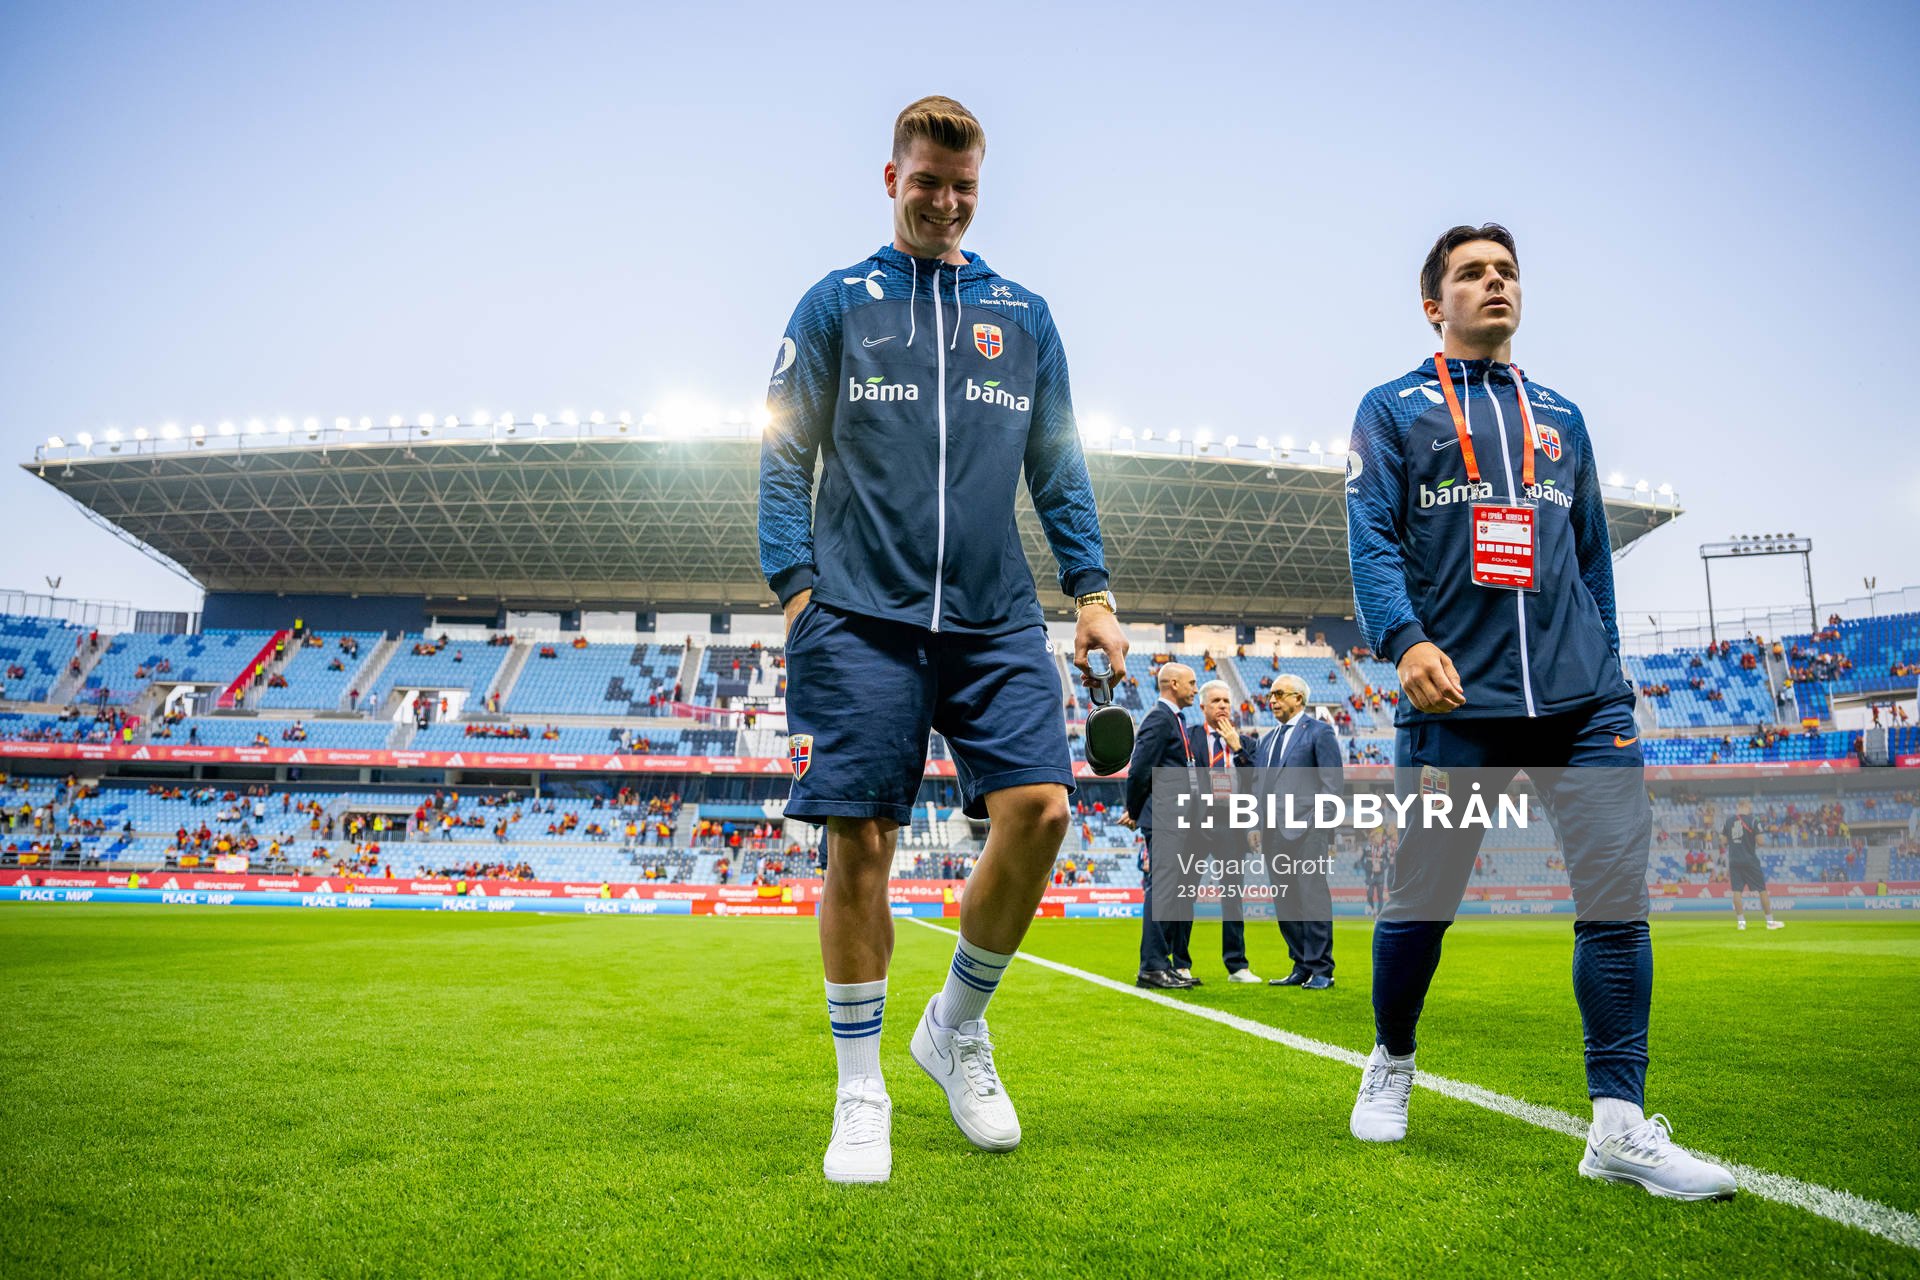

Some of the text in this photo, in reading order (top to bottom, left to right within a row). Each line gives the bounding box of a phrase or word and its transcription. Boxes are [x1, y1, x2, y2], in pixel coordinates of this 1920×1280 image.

[1001, 300, 1029, 309] Tipping
[849, 377, 919, 402] bama
[966, 378, 1030, 412] bama
